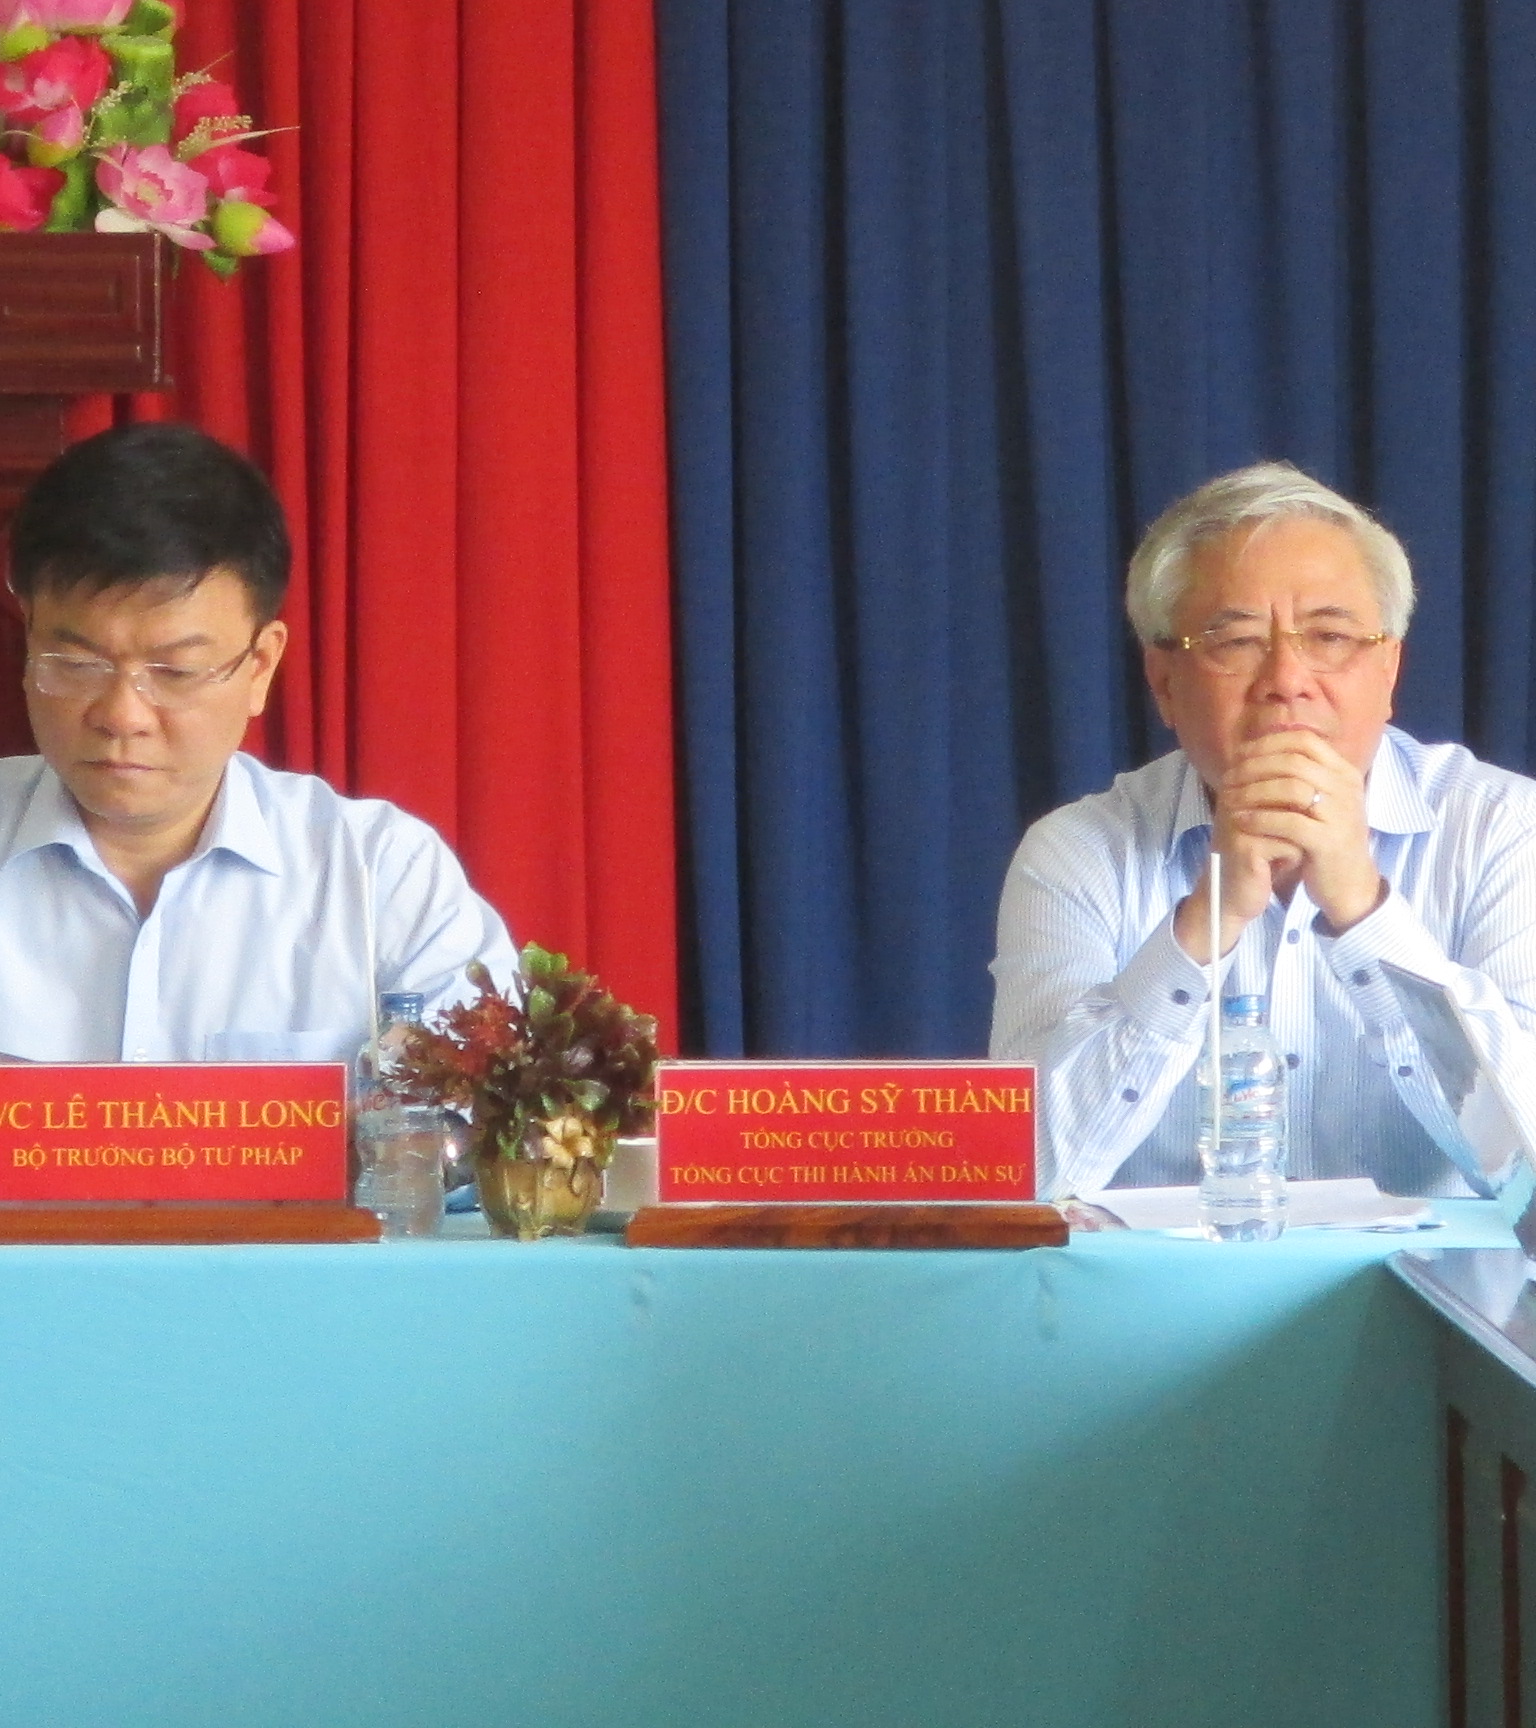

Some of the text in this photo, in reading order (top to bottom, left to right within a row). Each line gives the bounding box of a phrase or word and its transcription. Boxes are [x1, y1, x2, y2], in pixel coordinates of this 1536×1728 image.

[43, 1093, 88, 1129] LÊ
[97, 1092, 227, 1128] THÀNH
[238, 1100, 341, 1128] LONG
[661, 1080, 1032, 1115] Đ/C HOÀNG SỸ THÀNH
[808, 1131, 854, 1152] CỤC
[13, 1142, 47, 1170] BỘ
[161, 1142, 195, 1169] BỘ
[201, 1144, 236, 1166] TƯ
[241, 1142, 304, 1166] PHÁP
[738, 1166, 784, 1186] CỤC
[790, 1166, 825, 1183] THI
